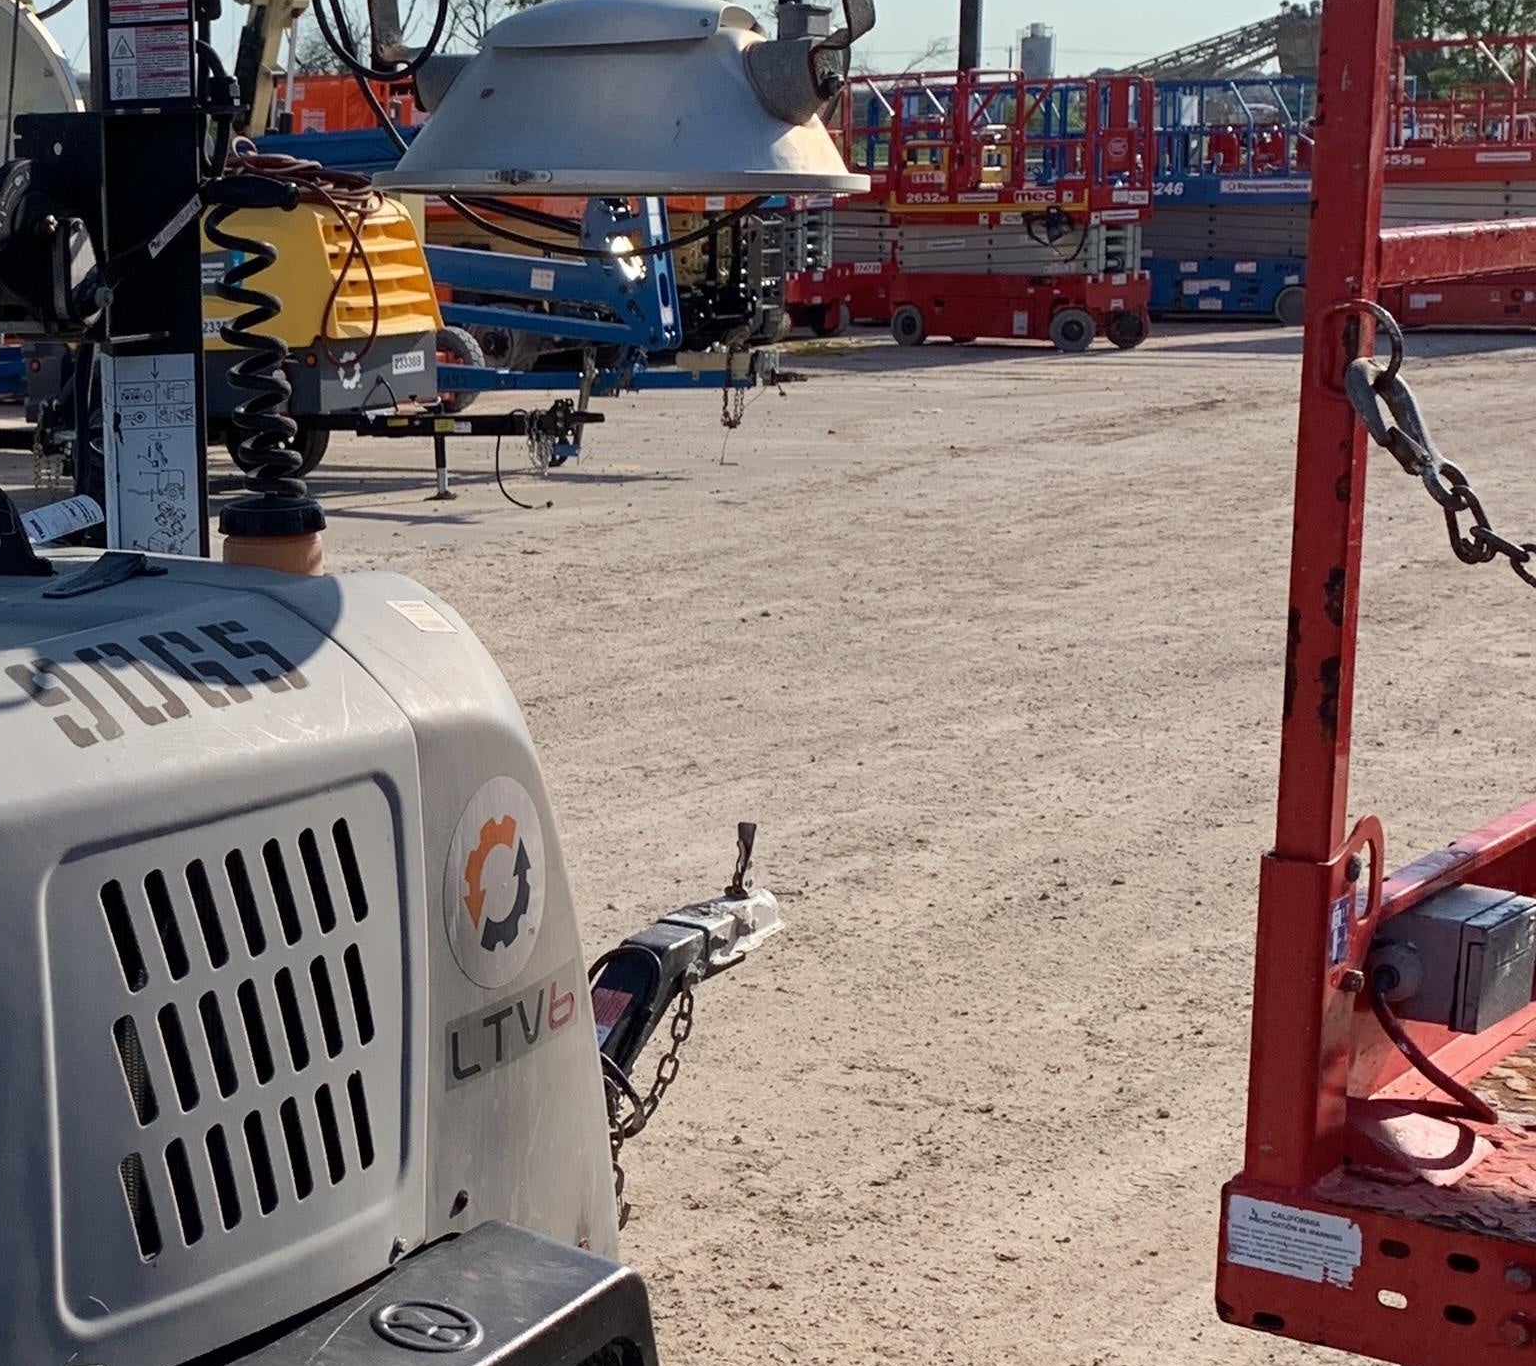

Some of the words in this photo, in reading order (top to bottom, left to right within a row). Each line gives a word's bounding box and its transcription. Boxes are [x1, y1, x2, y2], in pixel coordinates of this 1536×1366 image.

[1152, 181, 1185, 196] 246
[1013, 190, 1057, 204] mec
[202, 320, 223, 335] 233
[451, 980, 577, 1081] LTV6
[1270, 1210, 1322, 1228] CALIFORNIA
